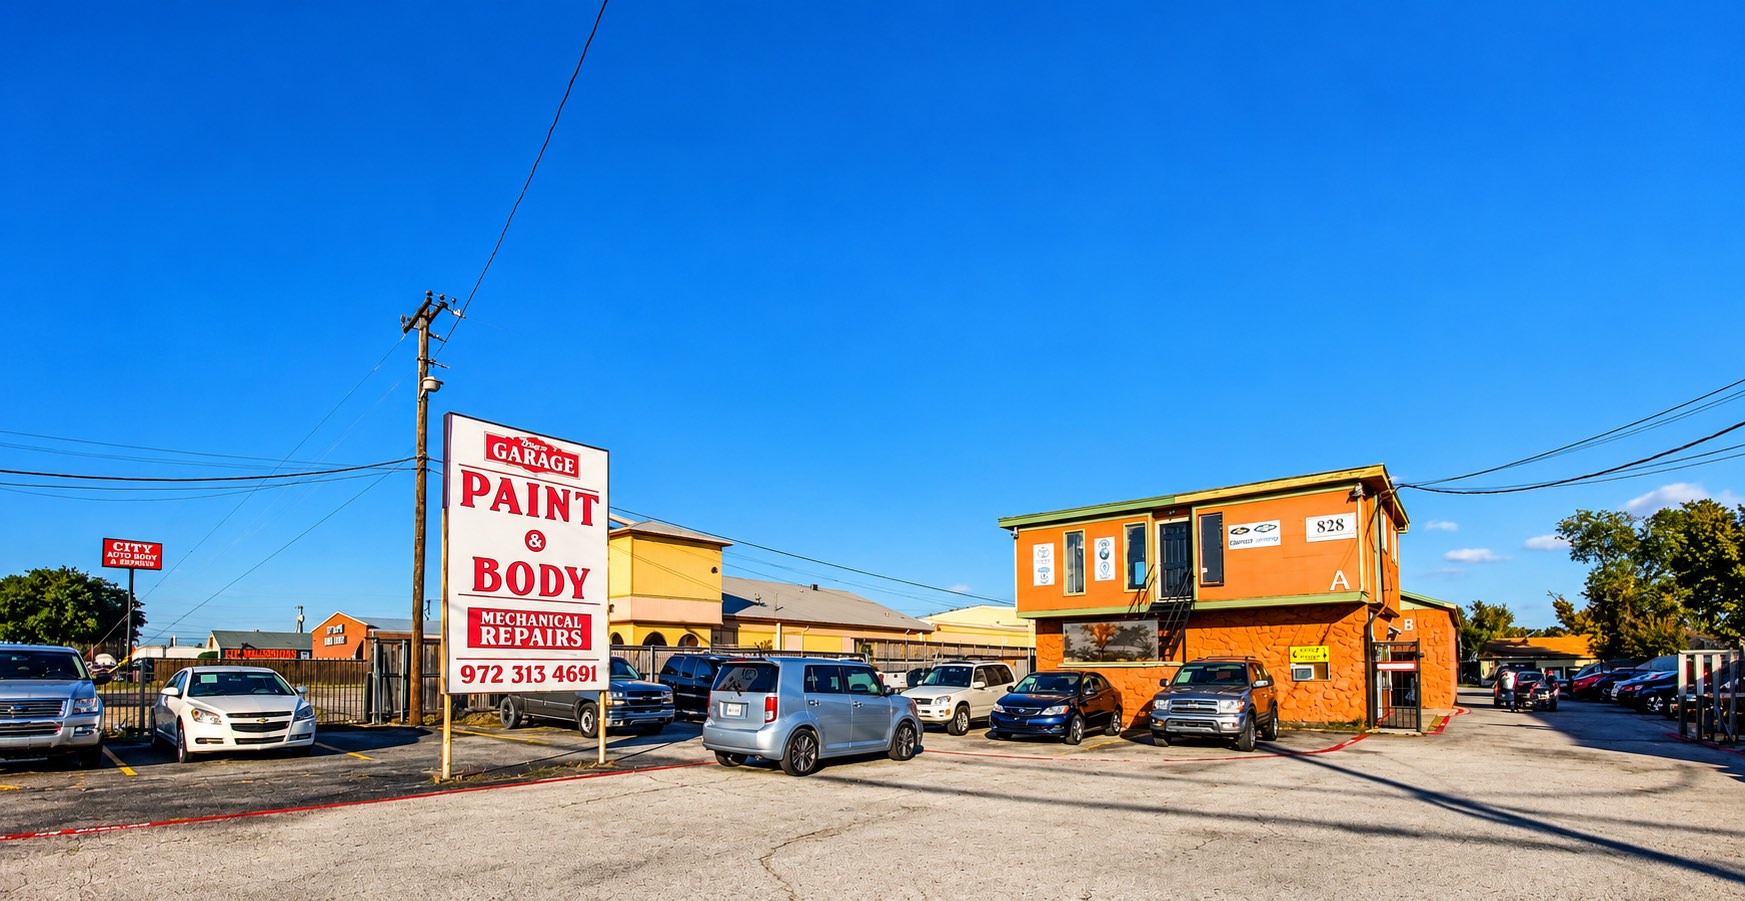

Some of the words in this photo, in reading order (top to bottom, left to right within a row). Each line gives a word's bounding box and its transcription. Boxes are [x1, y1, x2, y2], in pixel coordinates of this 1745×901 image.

[493, 442, 575, 474] GARAGE
[460, 469, 600, 527] PAINT
[1316, 518, 1345, 534] 828
[112, 541, 153, 554] CITY
[528, 533, 542, 548] &
[472, 556, 591, 599] BODY
[1329, 570, 1351, 591] A
[480, 611, 582, 629] MECHANICAL
[1403, 618, 1414, 631] B
[480, 626, 583, 647] REPAIRS
[460, 664, 504, 684] 972
[511, 665, 546, 684] 313
[551, 665, 598, 683] 4691
